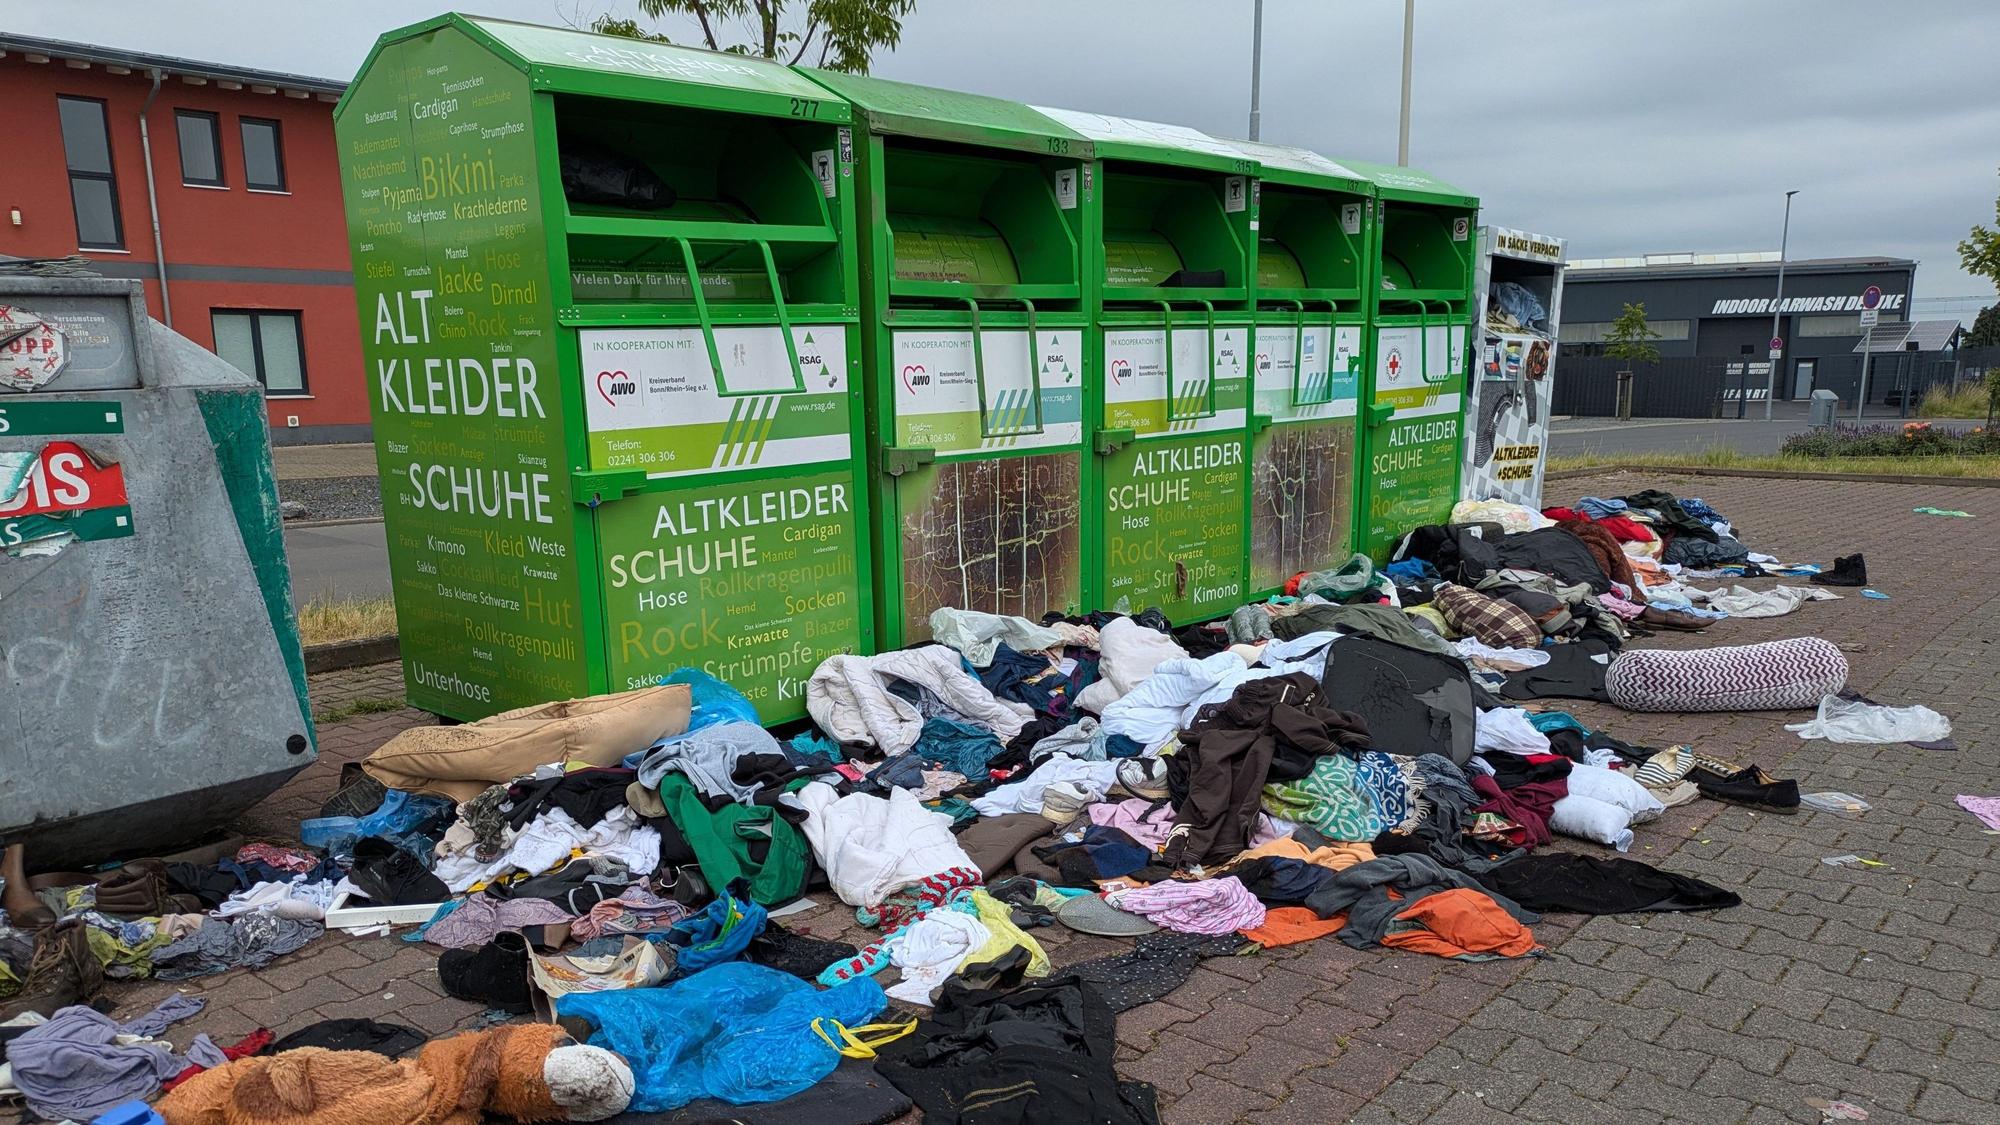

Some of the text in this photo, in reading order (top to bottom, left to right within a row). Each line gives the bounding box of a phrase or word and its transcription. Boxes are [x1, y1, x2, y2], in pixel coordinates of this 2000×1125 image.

[566, 51, 704, 79] SCHUHE
[590, 45, 766, 78] ALTKLEIDER
[442, 75, 484, 95] Tennissocken
[365, 109, 397, 125] Badeanzug
[413, 98, 459, 120] Cardigan
[790, 98, 819, 118] 277
[449, 121, 478, 136] Caprihose
[481, 122, 525, 140] Strumpfhose
[353, 134, 401, 156] Bademantel
[1048, 137, 1068, 154] 133
[352, 156, 407, 181] Nachthemd
[421, 148, 496, 200] Bikini
[500, 174, 525, 189] Parka
[382, 186, 423, 212] Pyjama
[453, 197, 528, 221] Krachlederne
[366, 219, 402, 237] Poncho
[494, 222, 526, 241] Leggins
[360, 242, 375, 253] Jeans
[445, 246, 469, 260] Mantel
[1498, 235, 1506, 248] IN
[1530, 242, 1560, 257] VERPACKT
[484, 248, 521, 271] Hose
[366, 261, 396, 279] Stiefel
[573, 273, 610, 285] Vielen
[613, 273, 643, 285] Dank
[645, 273, 661, 285] für
[665, 274, 687, 285] Ihre
[437, 265, 484, 297] Jacke
[491, 279, 537, 306] Dirndl
[444, 306, 464, 316] Bolero
[1712, 299, 1769, 314] INDOOR
[1768, 296, 1847, 313] CARWASH
[375, 289, 433, 345] ALT
[467, 309, 510, 337] Rock
[518, 313, 536, 326] Frack
[438, 322, 467, 339] Chino
[490, 342, 513, 353] Tankini
[593, 340, 695, 351] IN KOOPERATION MIT:
[911, 340, 958, 350] KOOPERATION
[799, 355, 822, 365] RSAG
[1047, 355, 1064, 363] RSAG
[648, 376, 686, 385] Kreisverband
[912, 375, 930, 386] AWO
[1117, 368, 1131, 378] AWO
[377, 358, 547, 419] KLEIDER
[610, 381, 636, 396] AWO
[649, 383, 709, 394] Bonn/Rhein-Sieg e.V.
[790, 401, 836, 414] www.rsag.de
[494, 423, 546, 448] Strümpfe
[1389, 420, 1457, 447] ALTKLEIDER
[387, 440, 409, 454] Blazer
[411, 433, 458, 458] Socken
[607, 440, 641, 452] Telefon:
[1493, 445, 1539, 461] ALTKLEIDER
[517, 453, 547, 469] Skianzug
[608, 451, 676, 467] 02241 306 306
[1133, 442, 1242, 477] ALTKLEIDER
[1373, 449, 1422, 475] SCHUHE
[1498, 465, 1533, 480] +SCHUHE
[409, 462, 553, 524] SCHUHE
[1109, 471, 1237, 512] SCHUHE Cardigan
[1380, 478, 1397, 489] Hose
[400, 493, 411, 505] BH
[1372, 493, 1406, 519] Rock
[652, 483, 849, 539] ALTKLEIDER
[1156, 496, 1242, 525] Rollkragenpulli
[1122, 511, 1150, 530] Hose
[1202, 522, 1237, 540] Socken
[427, 534, 466, 556] Kimono
[484, 529, 525, 559] Kleid
[527, 535, 566, 558] Weste
[1111, 531, 1167, 567] Rock
[1212, 543, 1239, 558] Blazer
[610, 522, 841, 588] SCHUHE Cardigan
[761, 548, 797, 564] Mantel
[1168, 548, 1203, 563] Krawatte
[416, 560, 437, 575] Sakko
[441, 558, 520, 589] Cocktailkleid
[523, 565, 558, 581] Krawatte
[700, 554, 853, 601] Rollkragenpulli
[1112, 576, 1132, 588] Sakko
[437, 583, 520, 611] Das kleine Schwarze
[1134, 586, 1148, 595] Chino
[1193, 583, 1238, 605] Kimono
[523, 585, 573, 629] Hut
[638, 589, 688, 612] Hose
[726, 601, 757, 616] Hemd
[785, 589, 846, 616] Socken
[619, 607, 723, 664] Rock
[805, 616, 852, 639] Blazer
[464, 616, 576, 662] Rollkragenpulli
[727, 626, 789, 650] Krawatte
[472, 647, 493, 661] Hemd
[703, 642, 812, 683] Strümpfe
[412, 661, 492, 703] Unterhose
[504, 661, 574, 694] Strickjacke
[627, 674, 663, 690] Sakko
